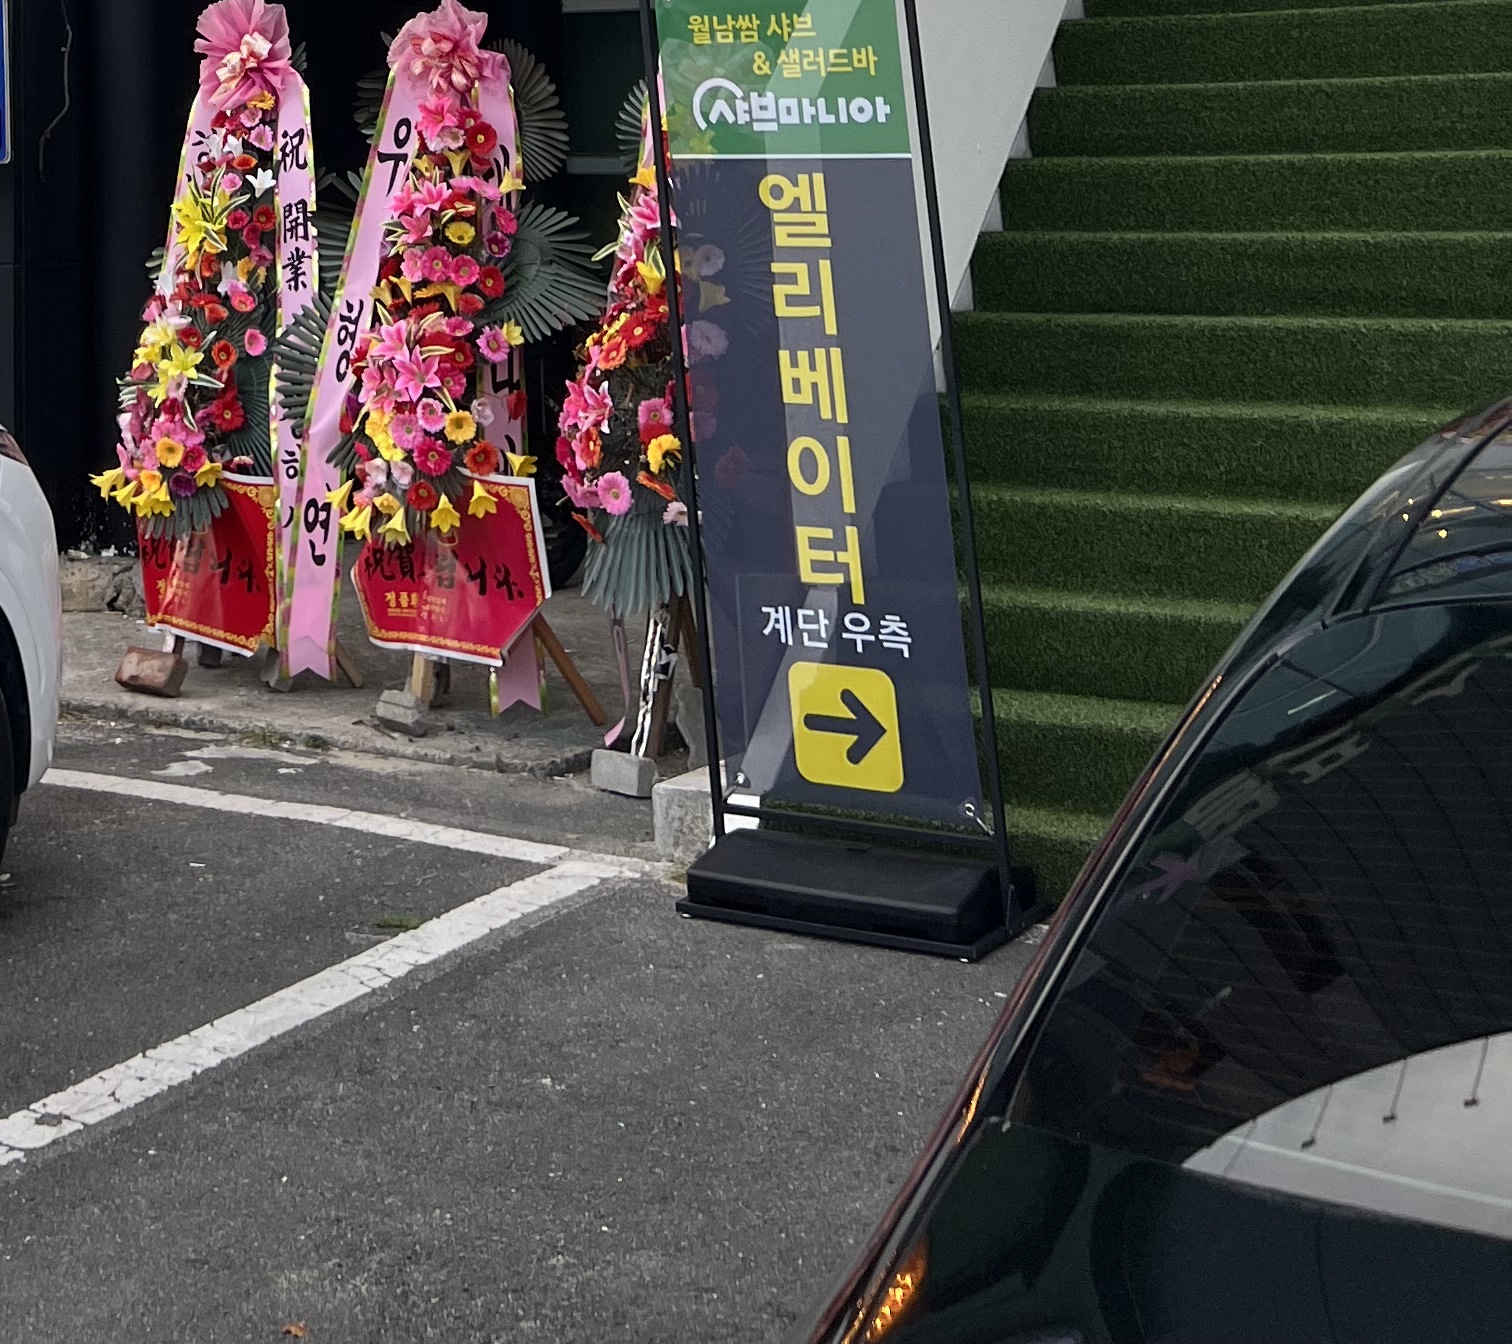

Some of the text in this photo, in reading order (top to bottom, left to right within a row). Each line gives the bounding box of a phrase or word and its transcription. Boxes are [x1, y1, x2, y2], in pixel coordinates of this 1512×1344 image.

[687, 12, 817, 45] 월남쌈 샤브
[752, 45, 878, 78] & 샐러드바
[692, 77, 891, 131] 샤브마니아
[757, 171, 866, 605] 엘리베이터
[760, 605, 913, 659] 계단 우측
